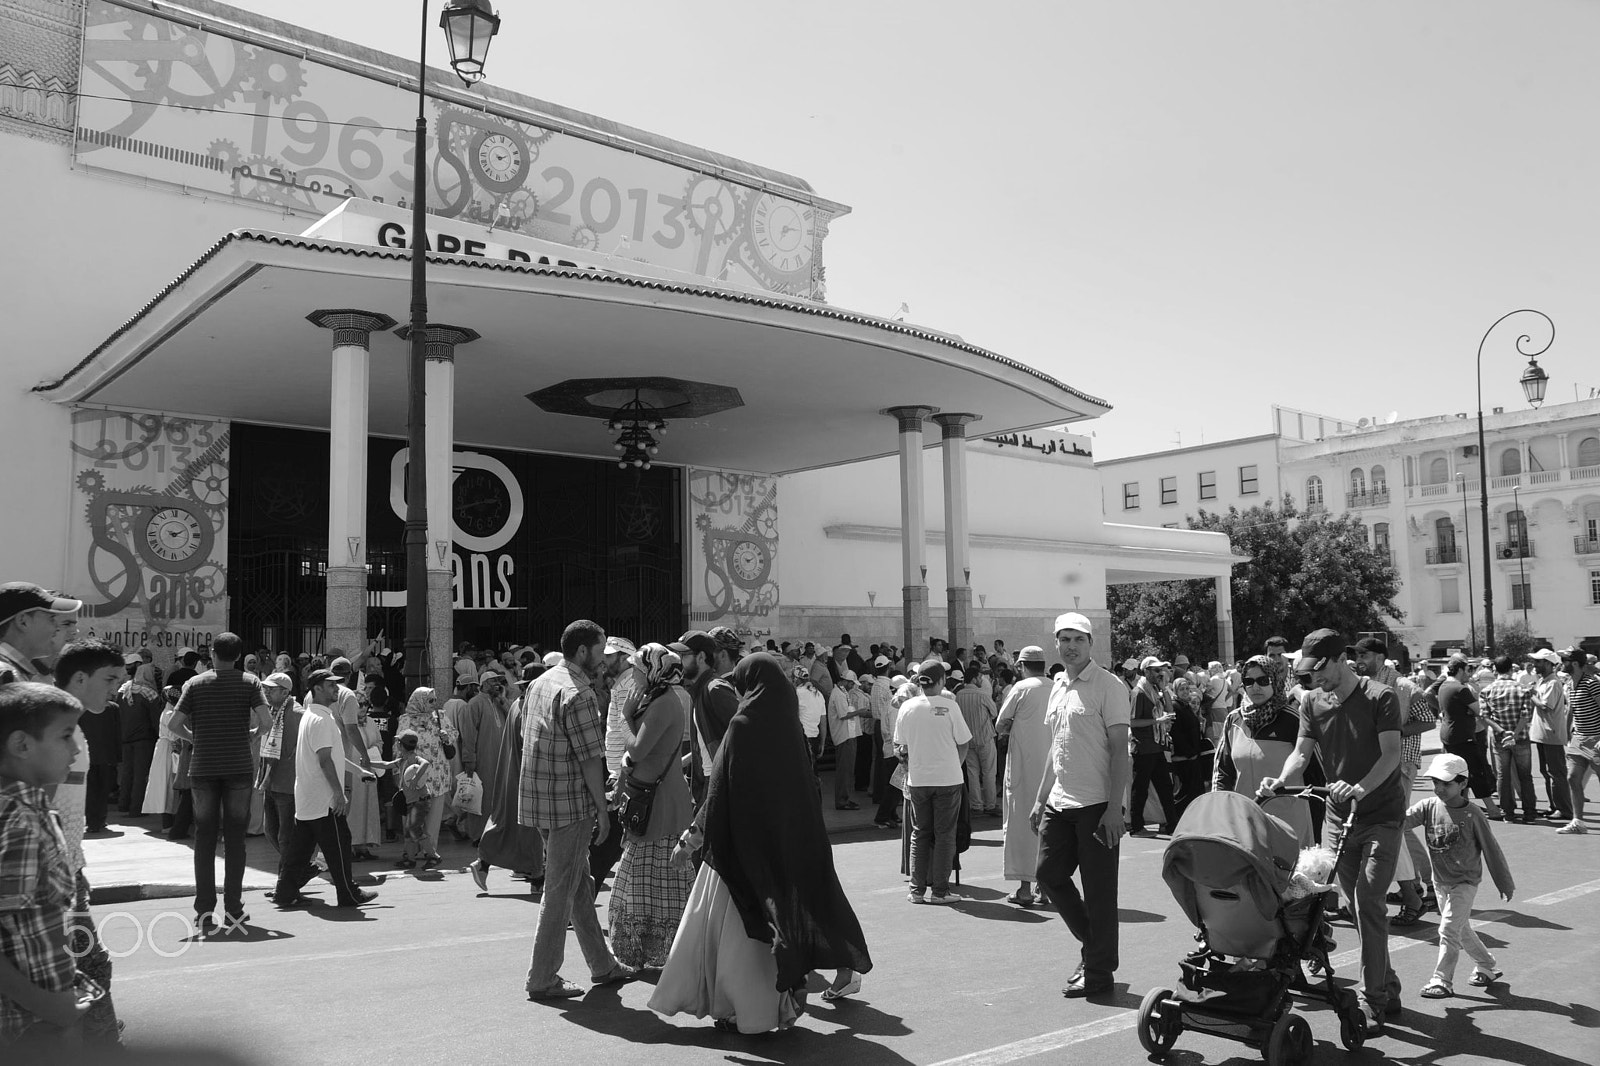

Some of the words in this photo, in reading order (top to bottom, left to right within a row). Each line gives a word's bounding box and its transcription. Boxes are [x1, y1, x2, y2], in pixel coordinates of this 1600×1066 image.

[242, 90, 432, 193] 1963
[536, 166, 686, 249] 2013
[377, 222, 487, 257] GRE
[119, 413, 214, 447] 1963
[94, 439, 193, 475] 2013
[704, 491, 757, 517] 2013
[150, 575, 205, 619] ans
[156, 628, 212, 648] service
